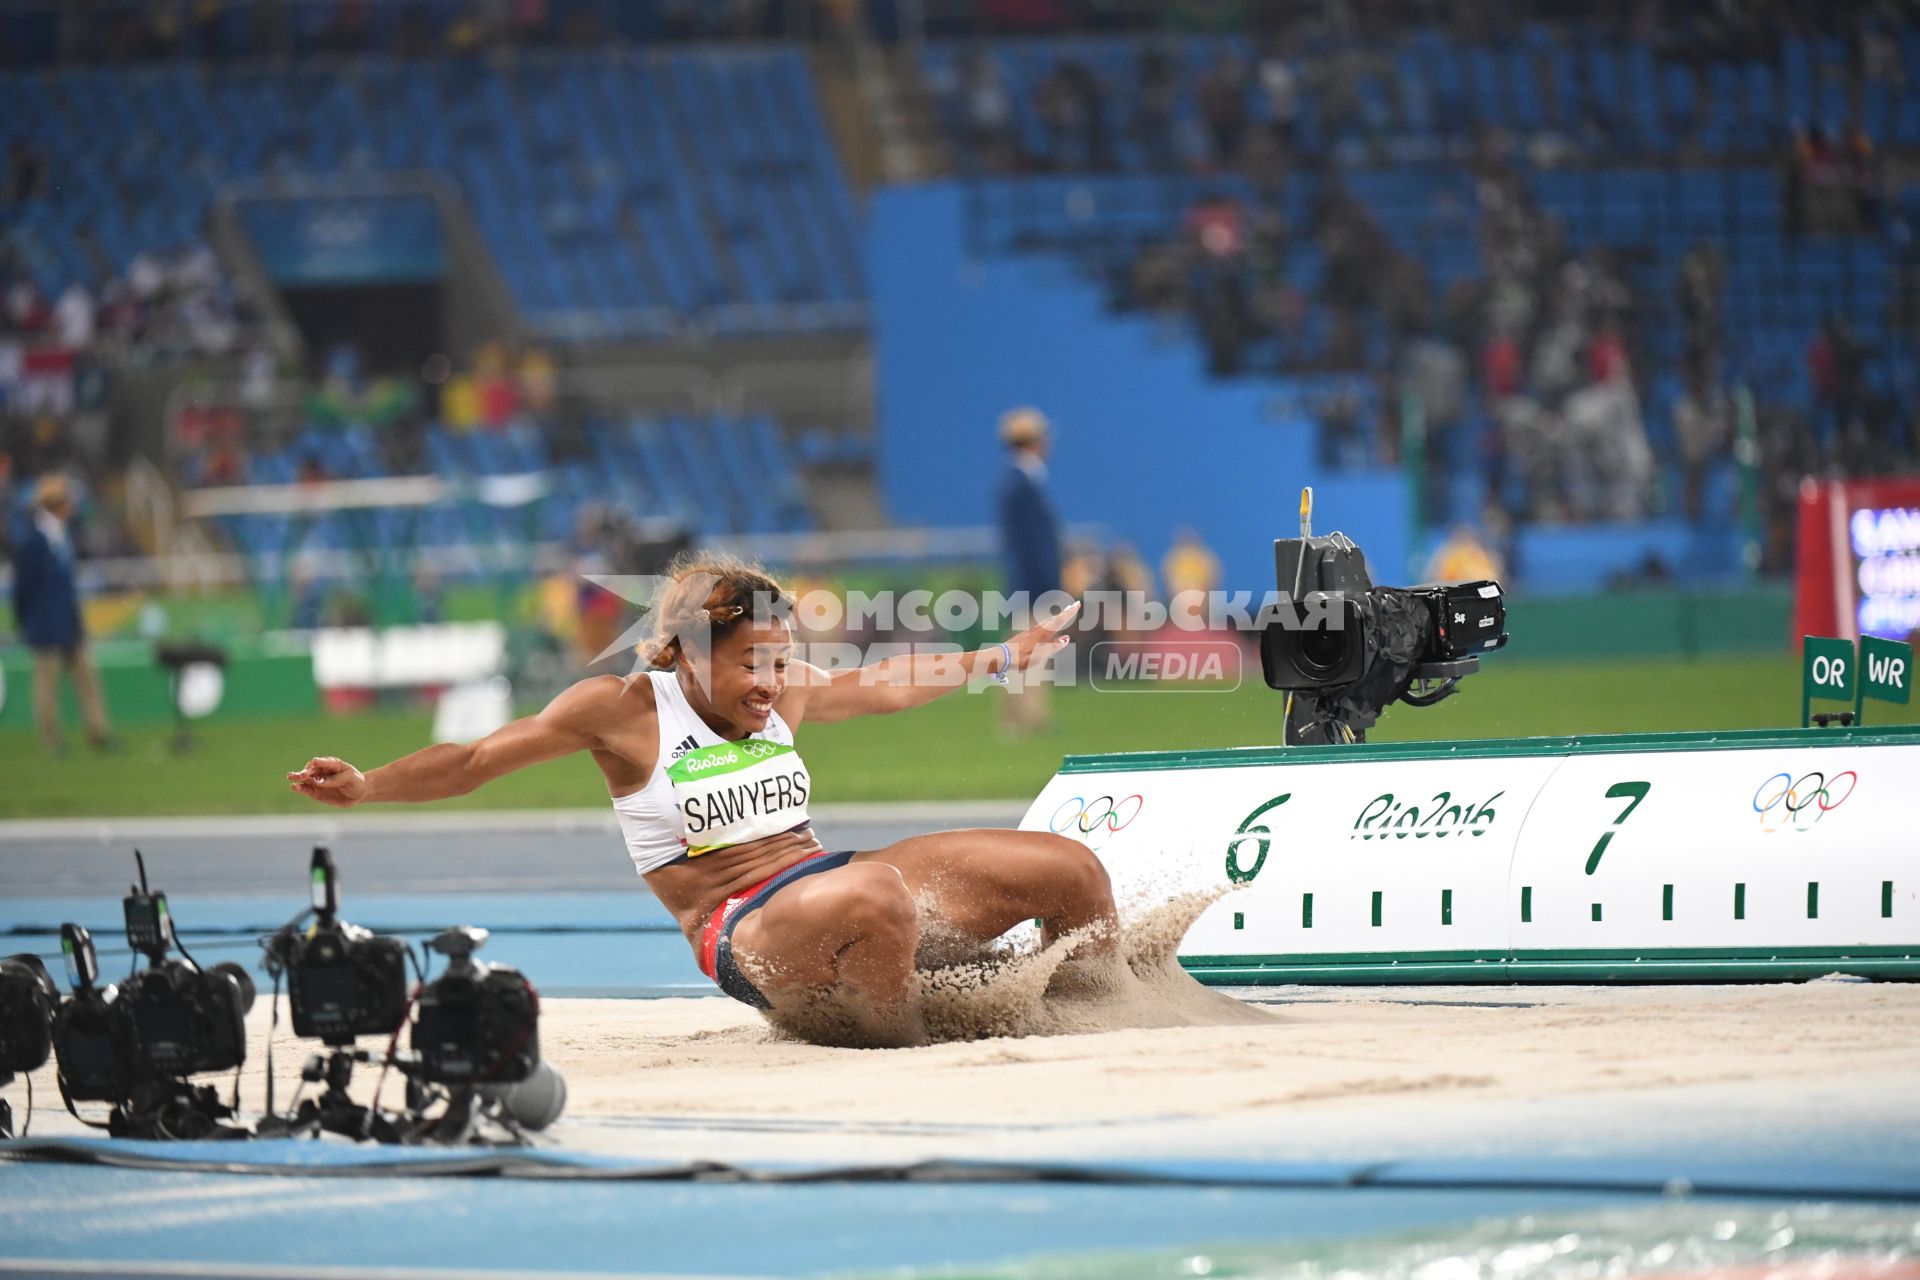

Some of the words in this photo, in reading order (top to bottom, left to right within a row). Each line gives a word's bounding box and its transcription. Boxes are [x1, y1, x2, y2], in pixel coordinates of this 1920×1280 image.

[1812, 655, 1845, 688] OR
[1868, 652, 1905, 689] WR
[687, 751, 738, 772] Rio2016
[685, 771, 807, 833] SAWYERS
[1350, 791, 1505, 841] Rio2016
[1225, 792, 1292, 884] 6
[1585, 781, 1652, 876] 7
